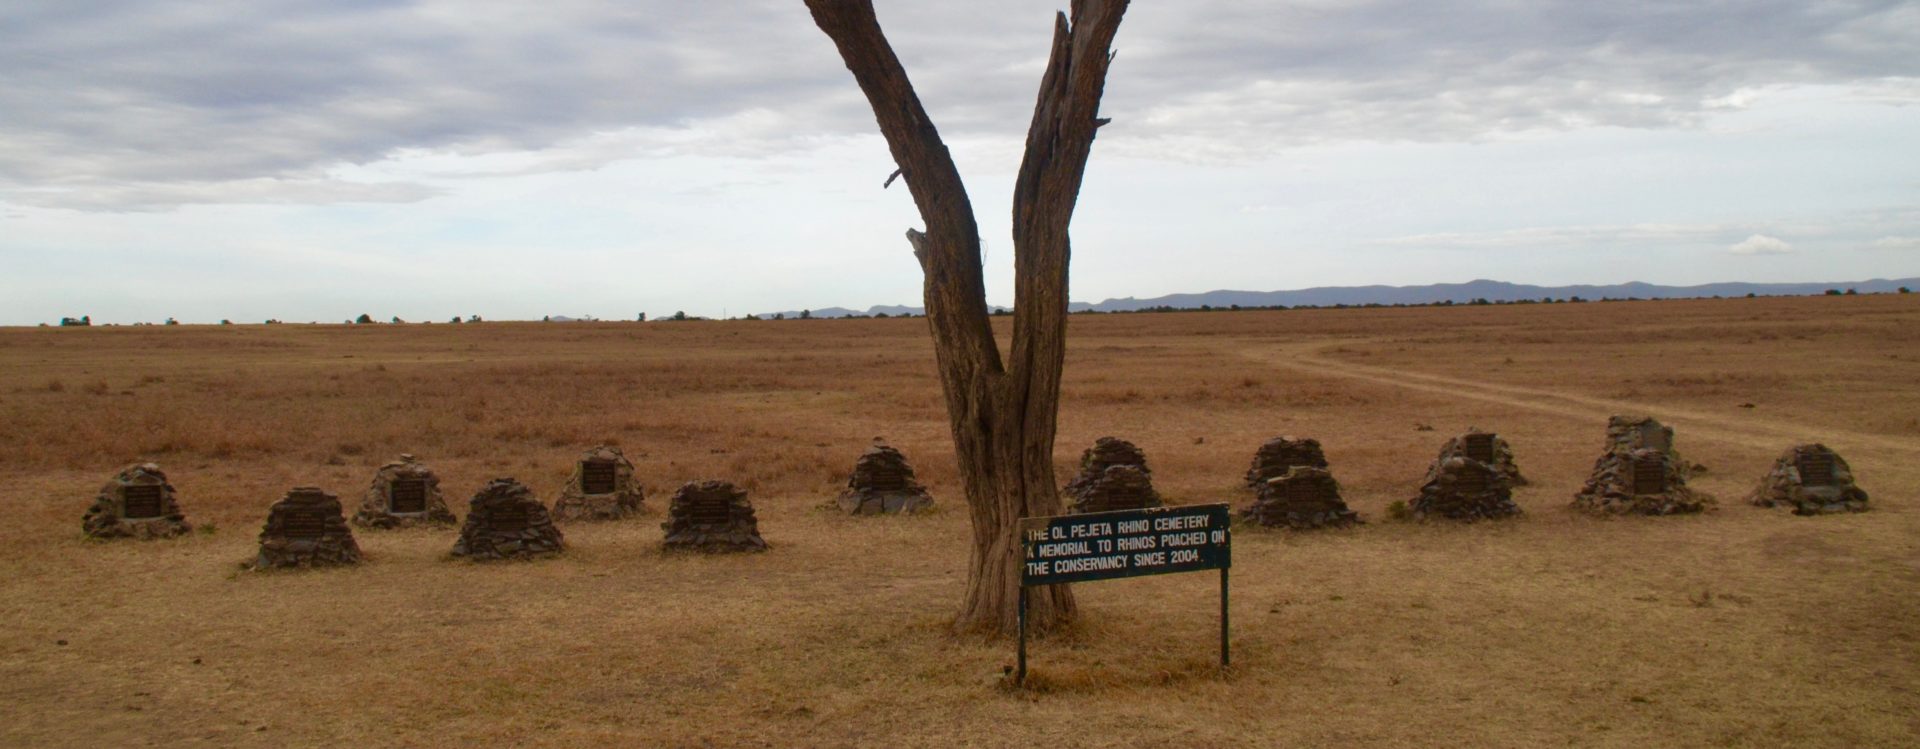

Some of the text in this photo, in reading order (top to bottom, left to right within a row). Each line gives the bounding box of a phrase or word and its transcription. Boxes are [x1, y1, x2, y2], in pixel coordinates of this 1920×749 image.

[1028, 514, 1209, 541] THE OL PEJETA RHINO CEMETERY
[1027, 530, 1224, 558] A MEMORIAL TO RHINOS POACHED ON
[1027, 561, 1048, 576] THE
[1054, 556, 1128, 574] CONSERVANCY
[1134, 552, 1165, 566] SINCE
